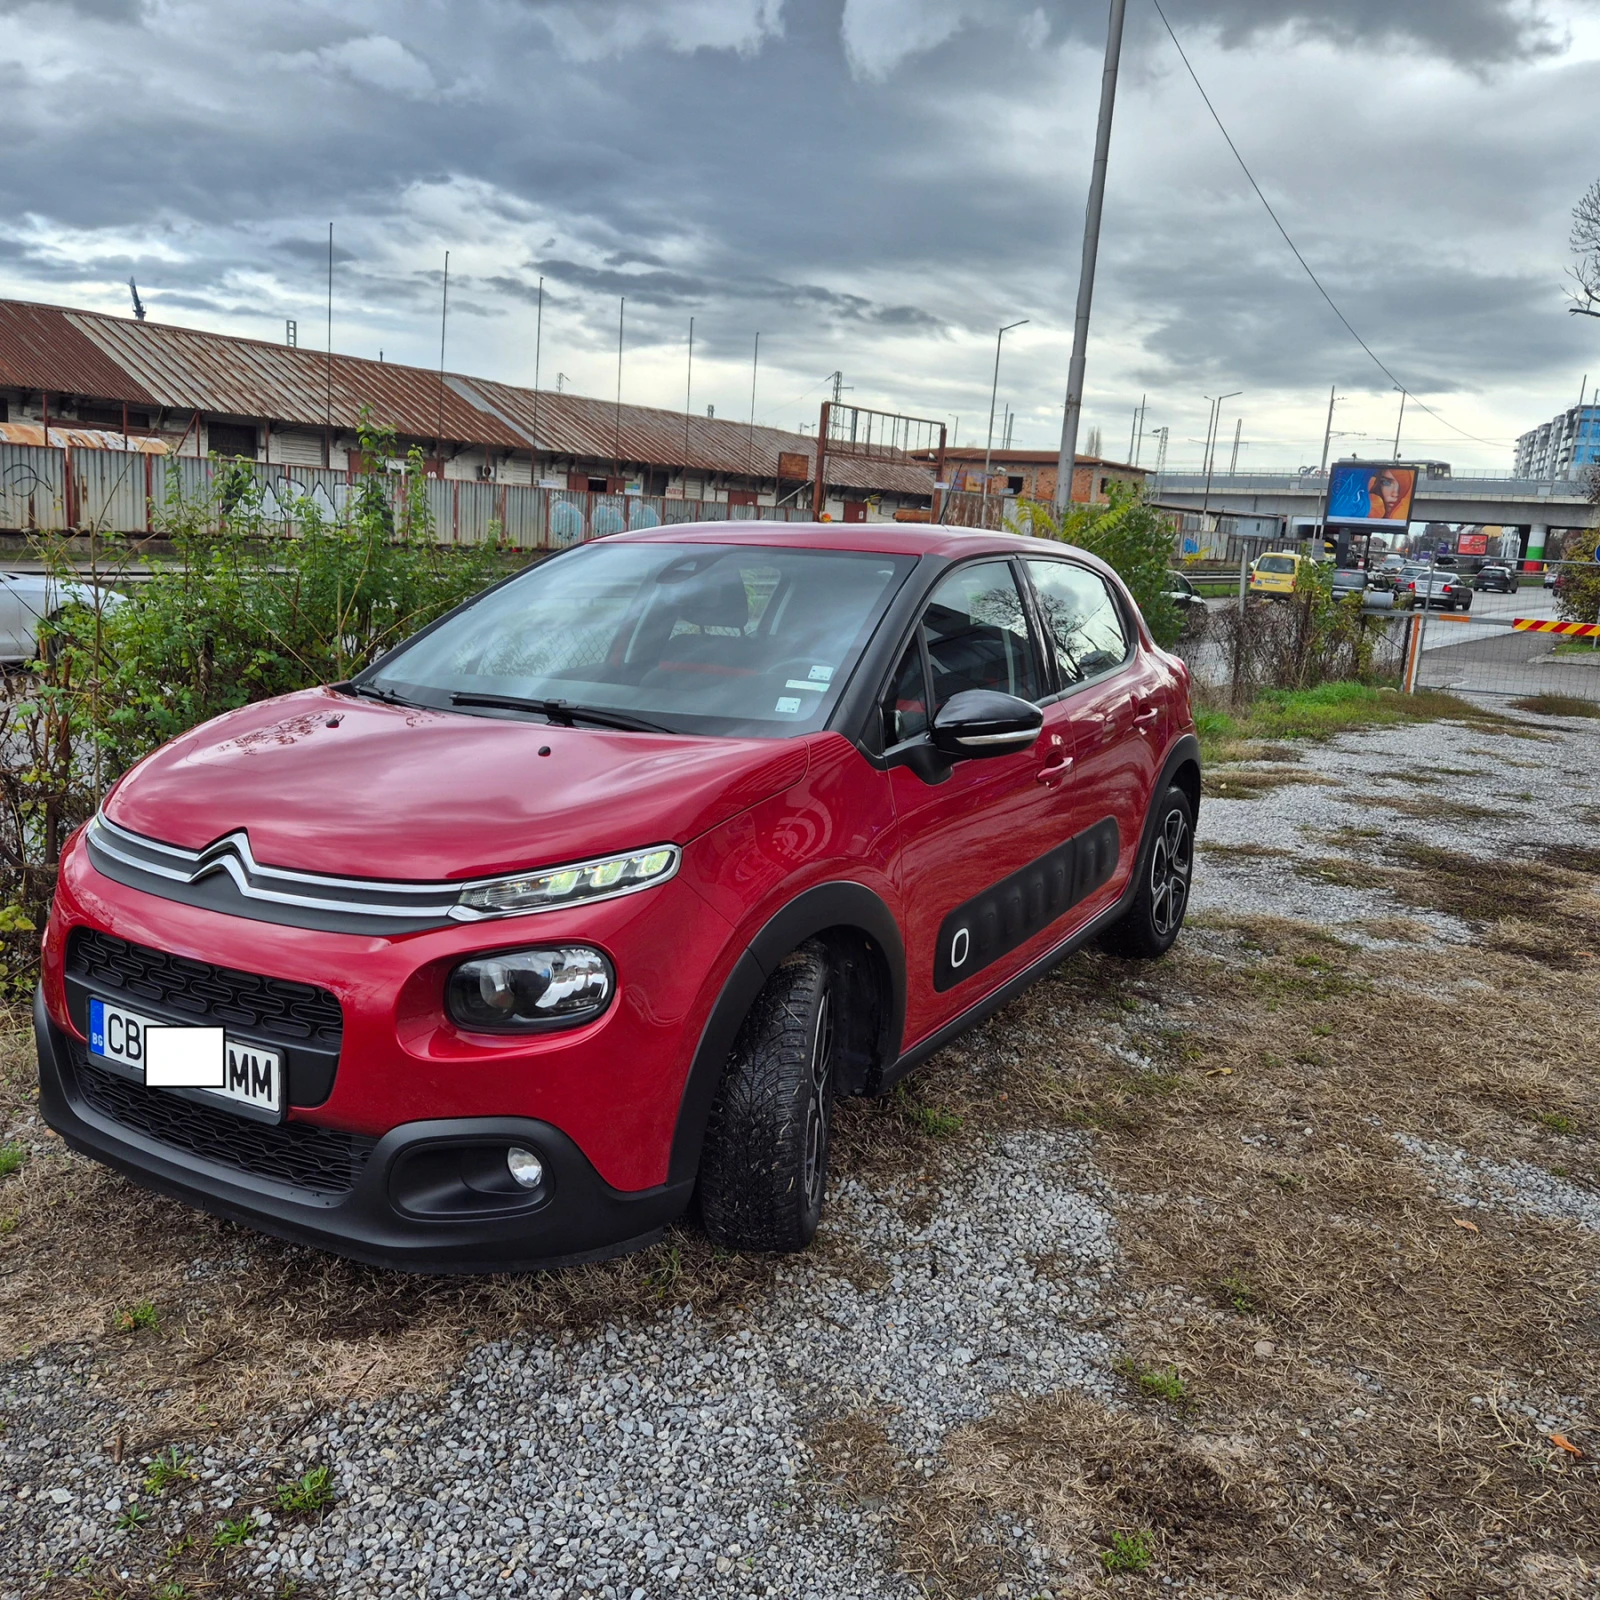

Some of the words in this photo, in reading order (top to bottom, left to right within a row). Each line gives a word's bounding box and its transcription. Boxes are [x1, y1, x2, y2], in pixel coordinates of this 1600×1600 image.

[92, 1032, 103, 1047] BG
[107, 1013, 142, 1061] CB
[229, 1050, 272, 1102] MM
